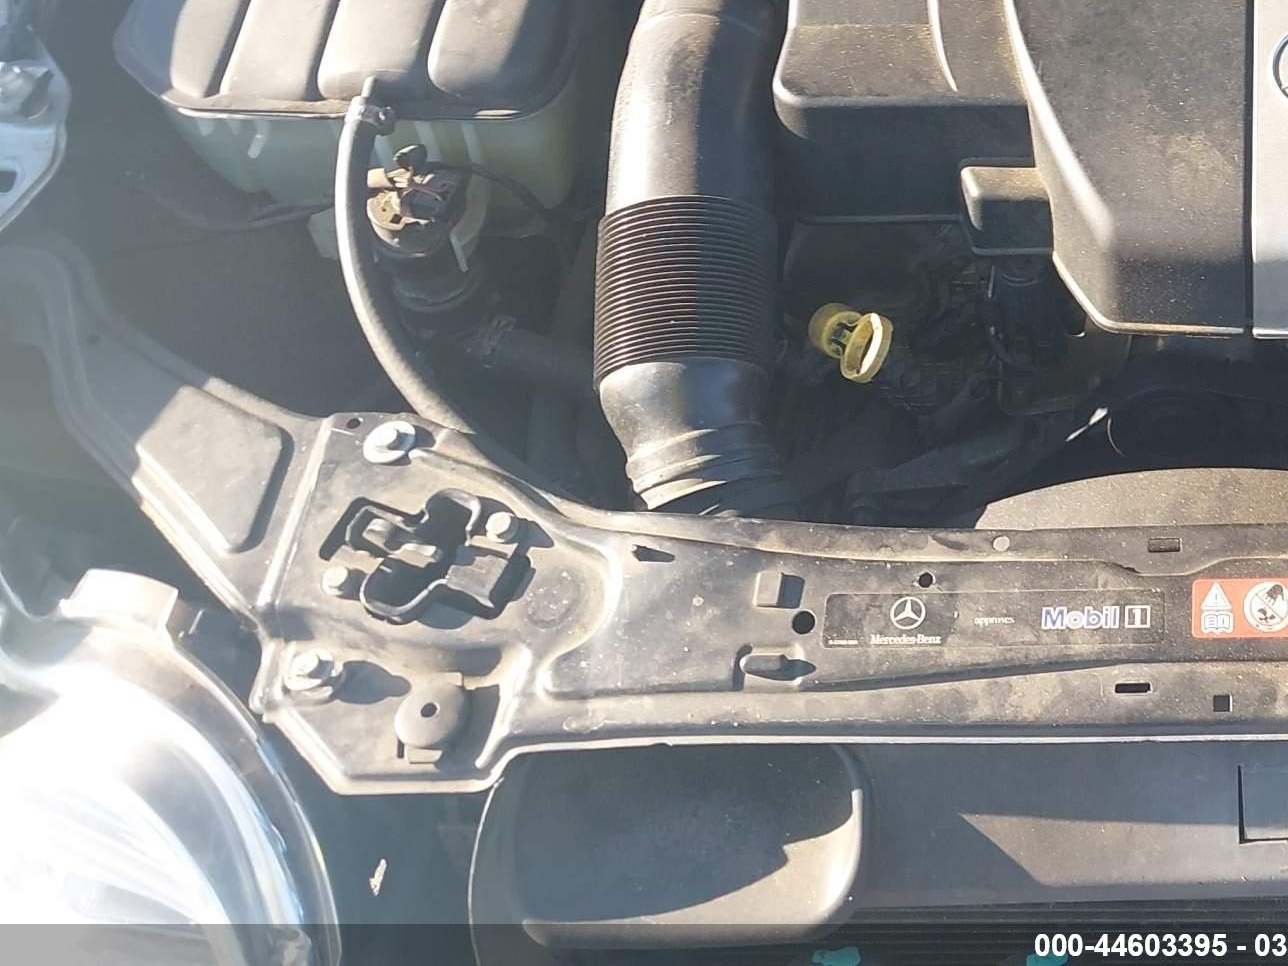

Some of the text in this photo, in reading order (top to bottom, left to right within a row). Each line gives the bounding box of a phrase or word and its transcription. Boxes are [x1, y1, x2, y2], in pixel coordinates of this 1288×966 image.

[1041, 605, 1120, 630] Mobil
[1129, 606, 1147, 629] 1
[870, 633, 942, 646] Mercedes-Benz
